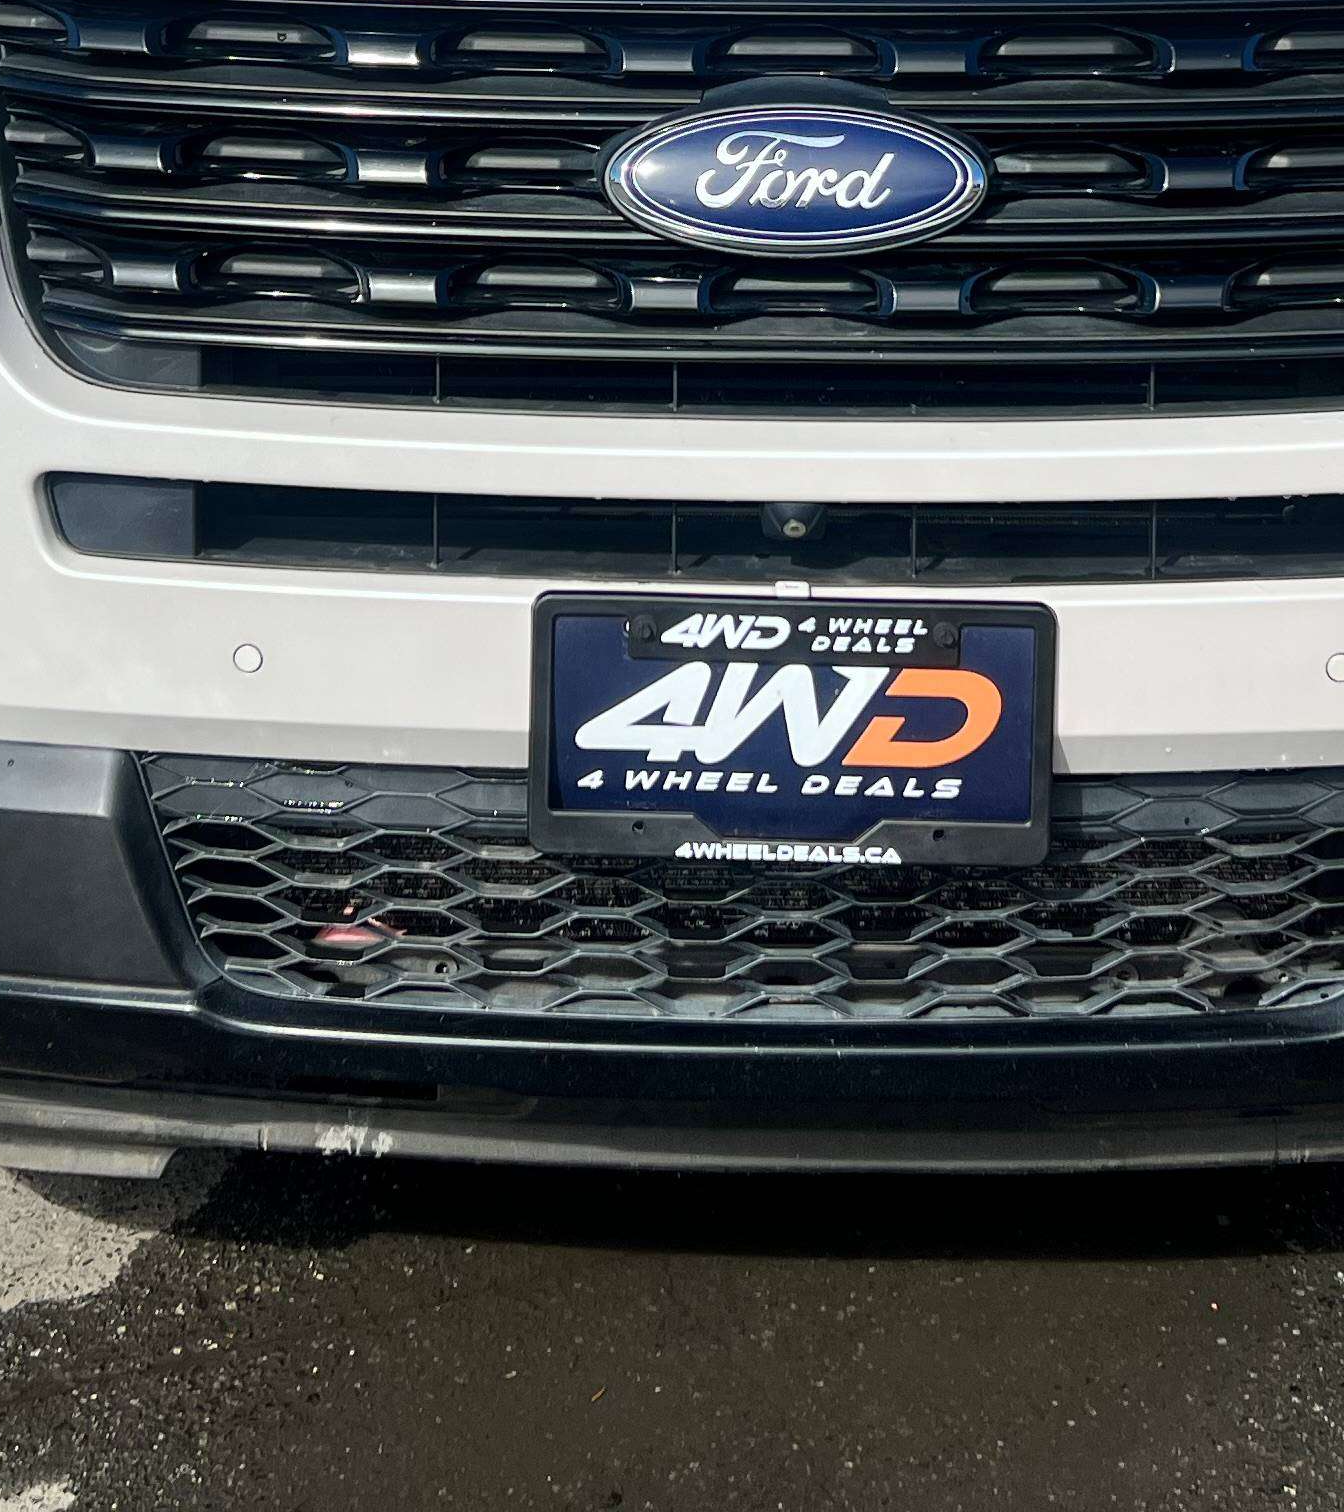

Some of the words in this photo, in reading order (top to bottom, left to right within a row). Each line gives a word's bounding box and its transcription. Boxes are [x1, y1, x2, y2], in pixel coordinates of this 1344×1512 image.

[694, 129, 891, 211] Ford
[661, 612, 791, 650] 4WD
[798, 617, 816, 633] 4
[828, 617, 928, 635] WHEEL
[811, 636, 916, 653] DEALS
[574, 660, 1002, 768] 4WD
[577, 769, 605, 790] 4
[625, 770, 778, 793] WHEEL
[801, 774, 962, 799] DEALS
[674, 841, 902, 865] 4WHEELDEALS.CA
